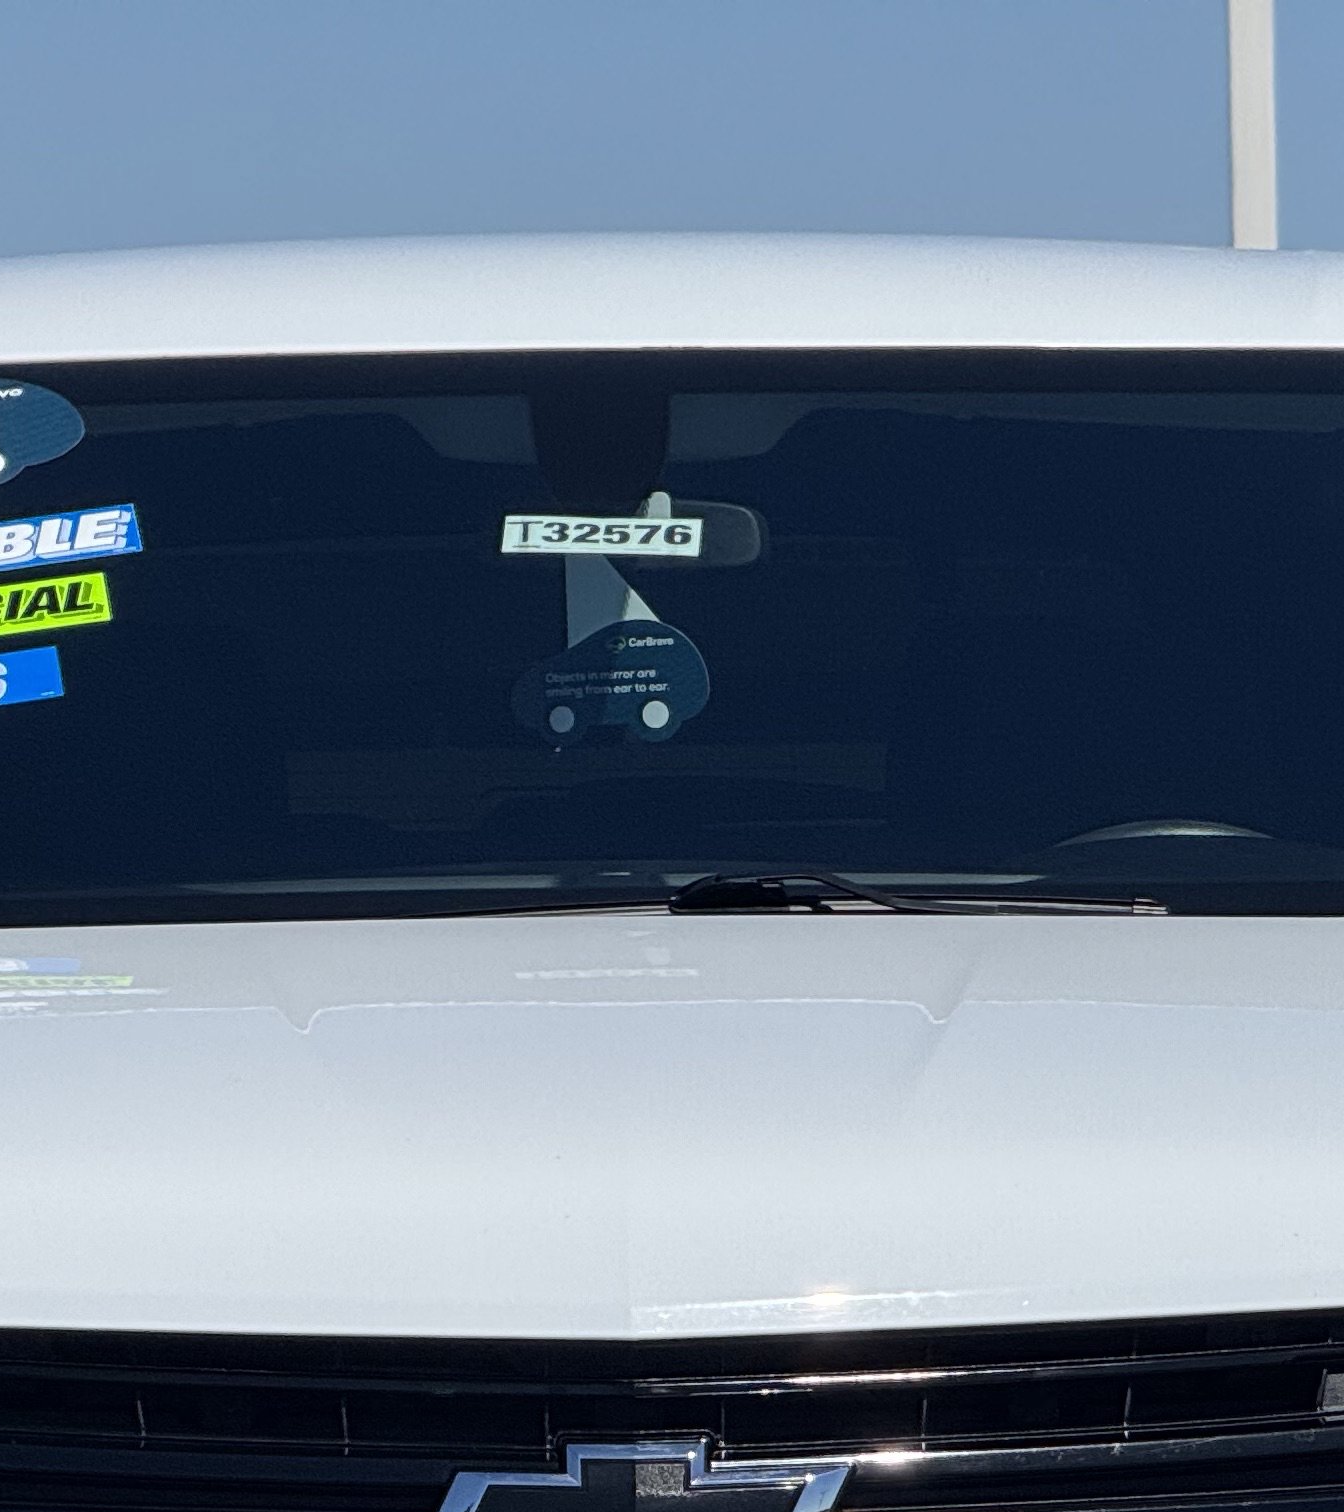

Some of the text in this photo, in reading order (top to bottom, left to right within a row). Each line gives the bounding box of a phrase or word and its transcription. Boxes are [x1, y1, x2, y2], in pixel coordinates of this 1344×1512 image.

[507, 520, 693, 546] T32576
[637, 669, 657, 679] are
[613, 684, 633, 694] ear
[635, 682, 648, 693] to
